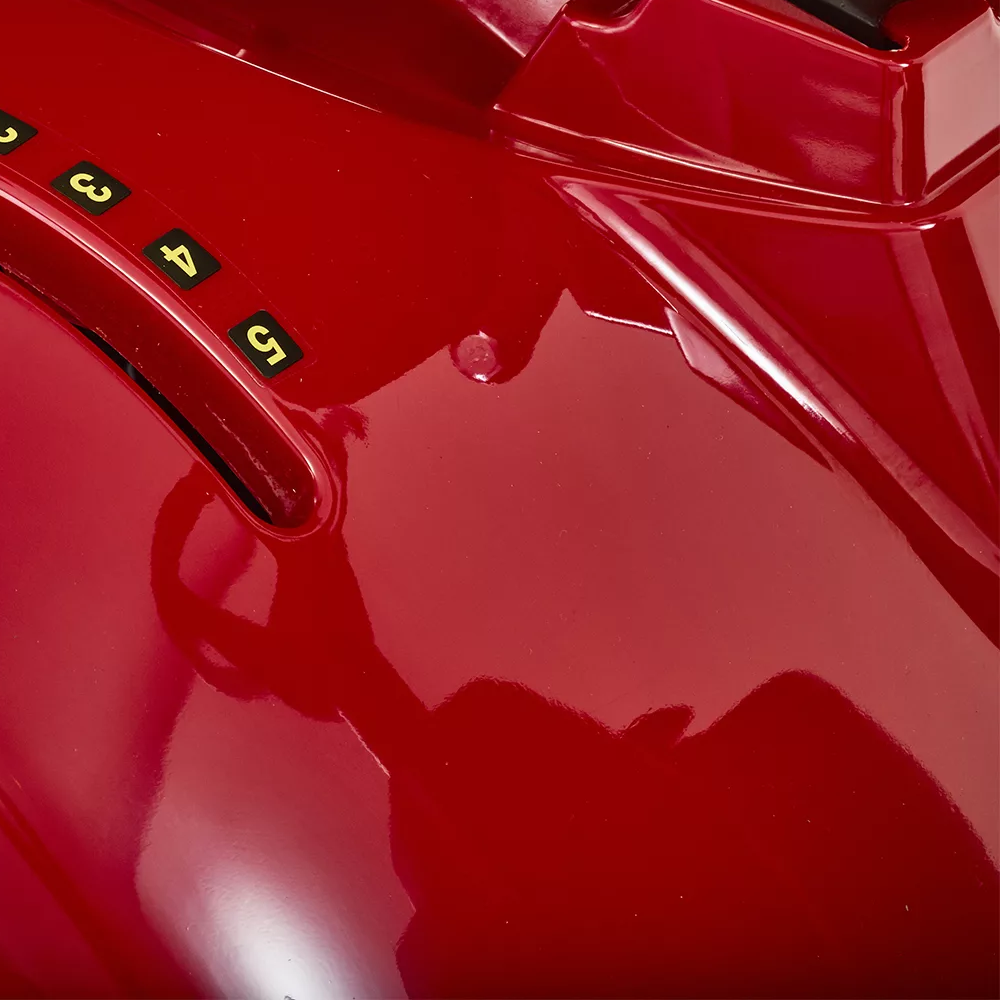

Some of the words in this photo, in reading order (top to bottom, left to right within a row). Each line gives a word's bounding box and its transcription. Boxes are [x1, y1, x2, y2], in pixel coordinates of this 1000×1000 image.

[69, 173, 112, 203] 3
[159, 244, 198, 278] 4
[246, 325, 287, 366] 5
